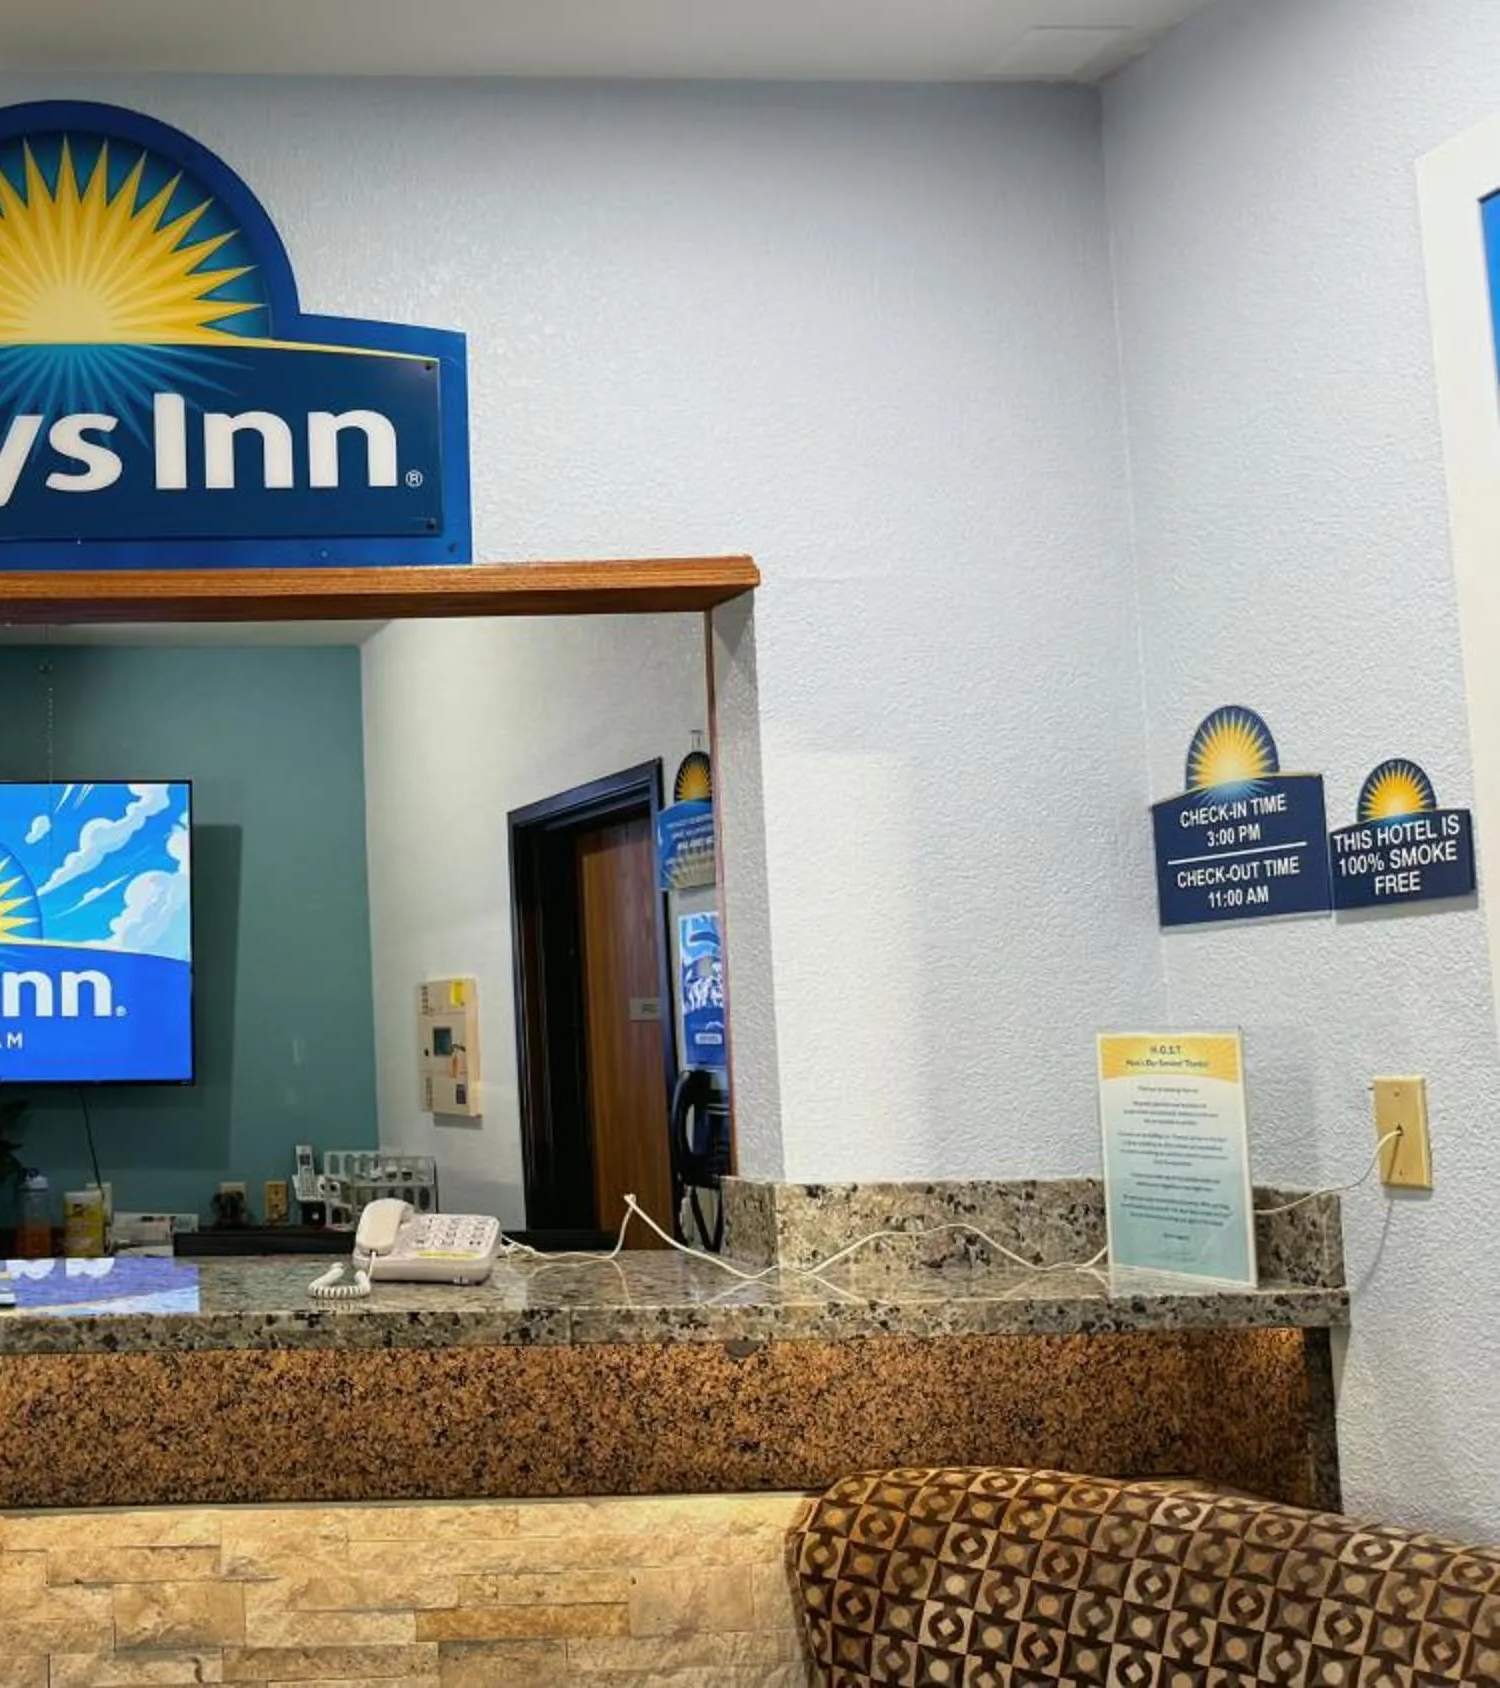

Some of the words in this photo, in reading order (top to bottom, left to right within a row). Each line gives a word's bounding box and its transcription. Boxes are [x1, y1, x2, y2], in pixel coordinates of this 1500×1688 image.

[1180, 801, 1247, 828] CHECK-IN
[1250, 794, 1287, 813] TIME
[1207, 829, 1235, 848] 3:00
[1238, 826, 1261, 844] PM
[1334, 831, 1372, 854] THIS
[1378, 820, 1437, 846] HOTEL
[1442, 815, 1460, 836] IS
[1177, 862, 1259, 889] CHECK-OUT
[1265, 856, 1300, 876] TIME
[1339, 852, 1385, 877] 100%
[1390, 841, 1457, 868] SMOKE
[1208, 890, 1243, 909] 11:00
[1246, 886, 1269, 904] AM
[1375, 872, 1420, 897] FREE
